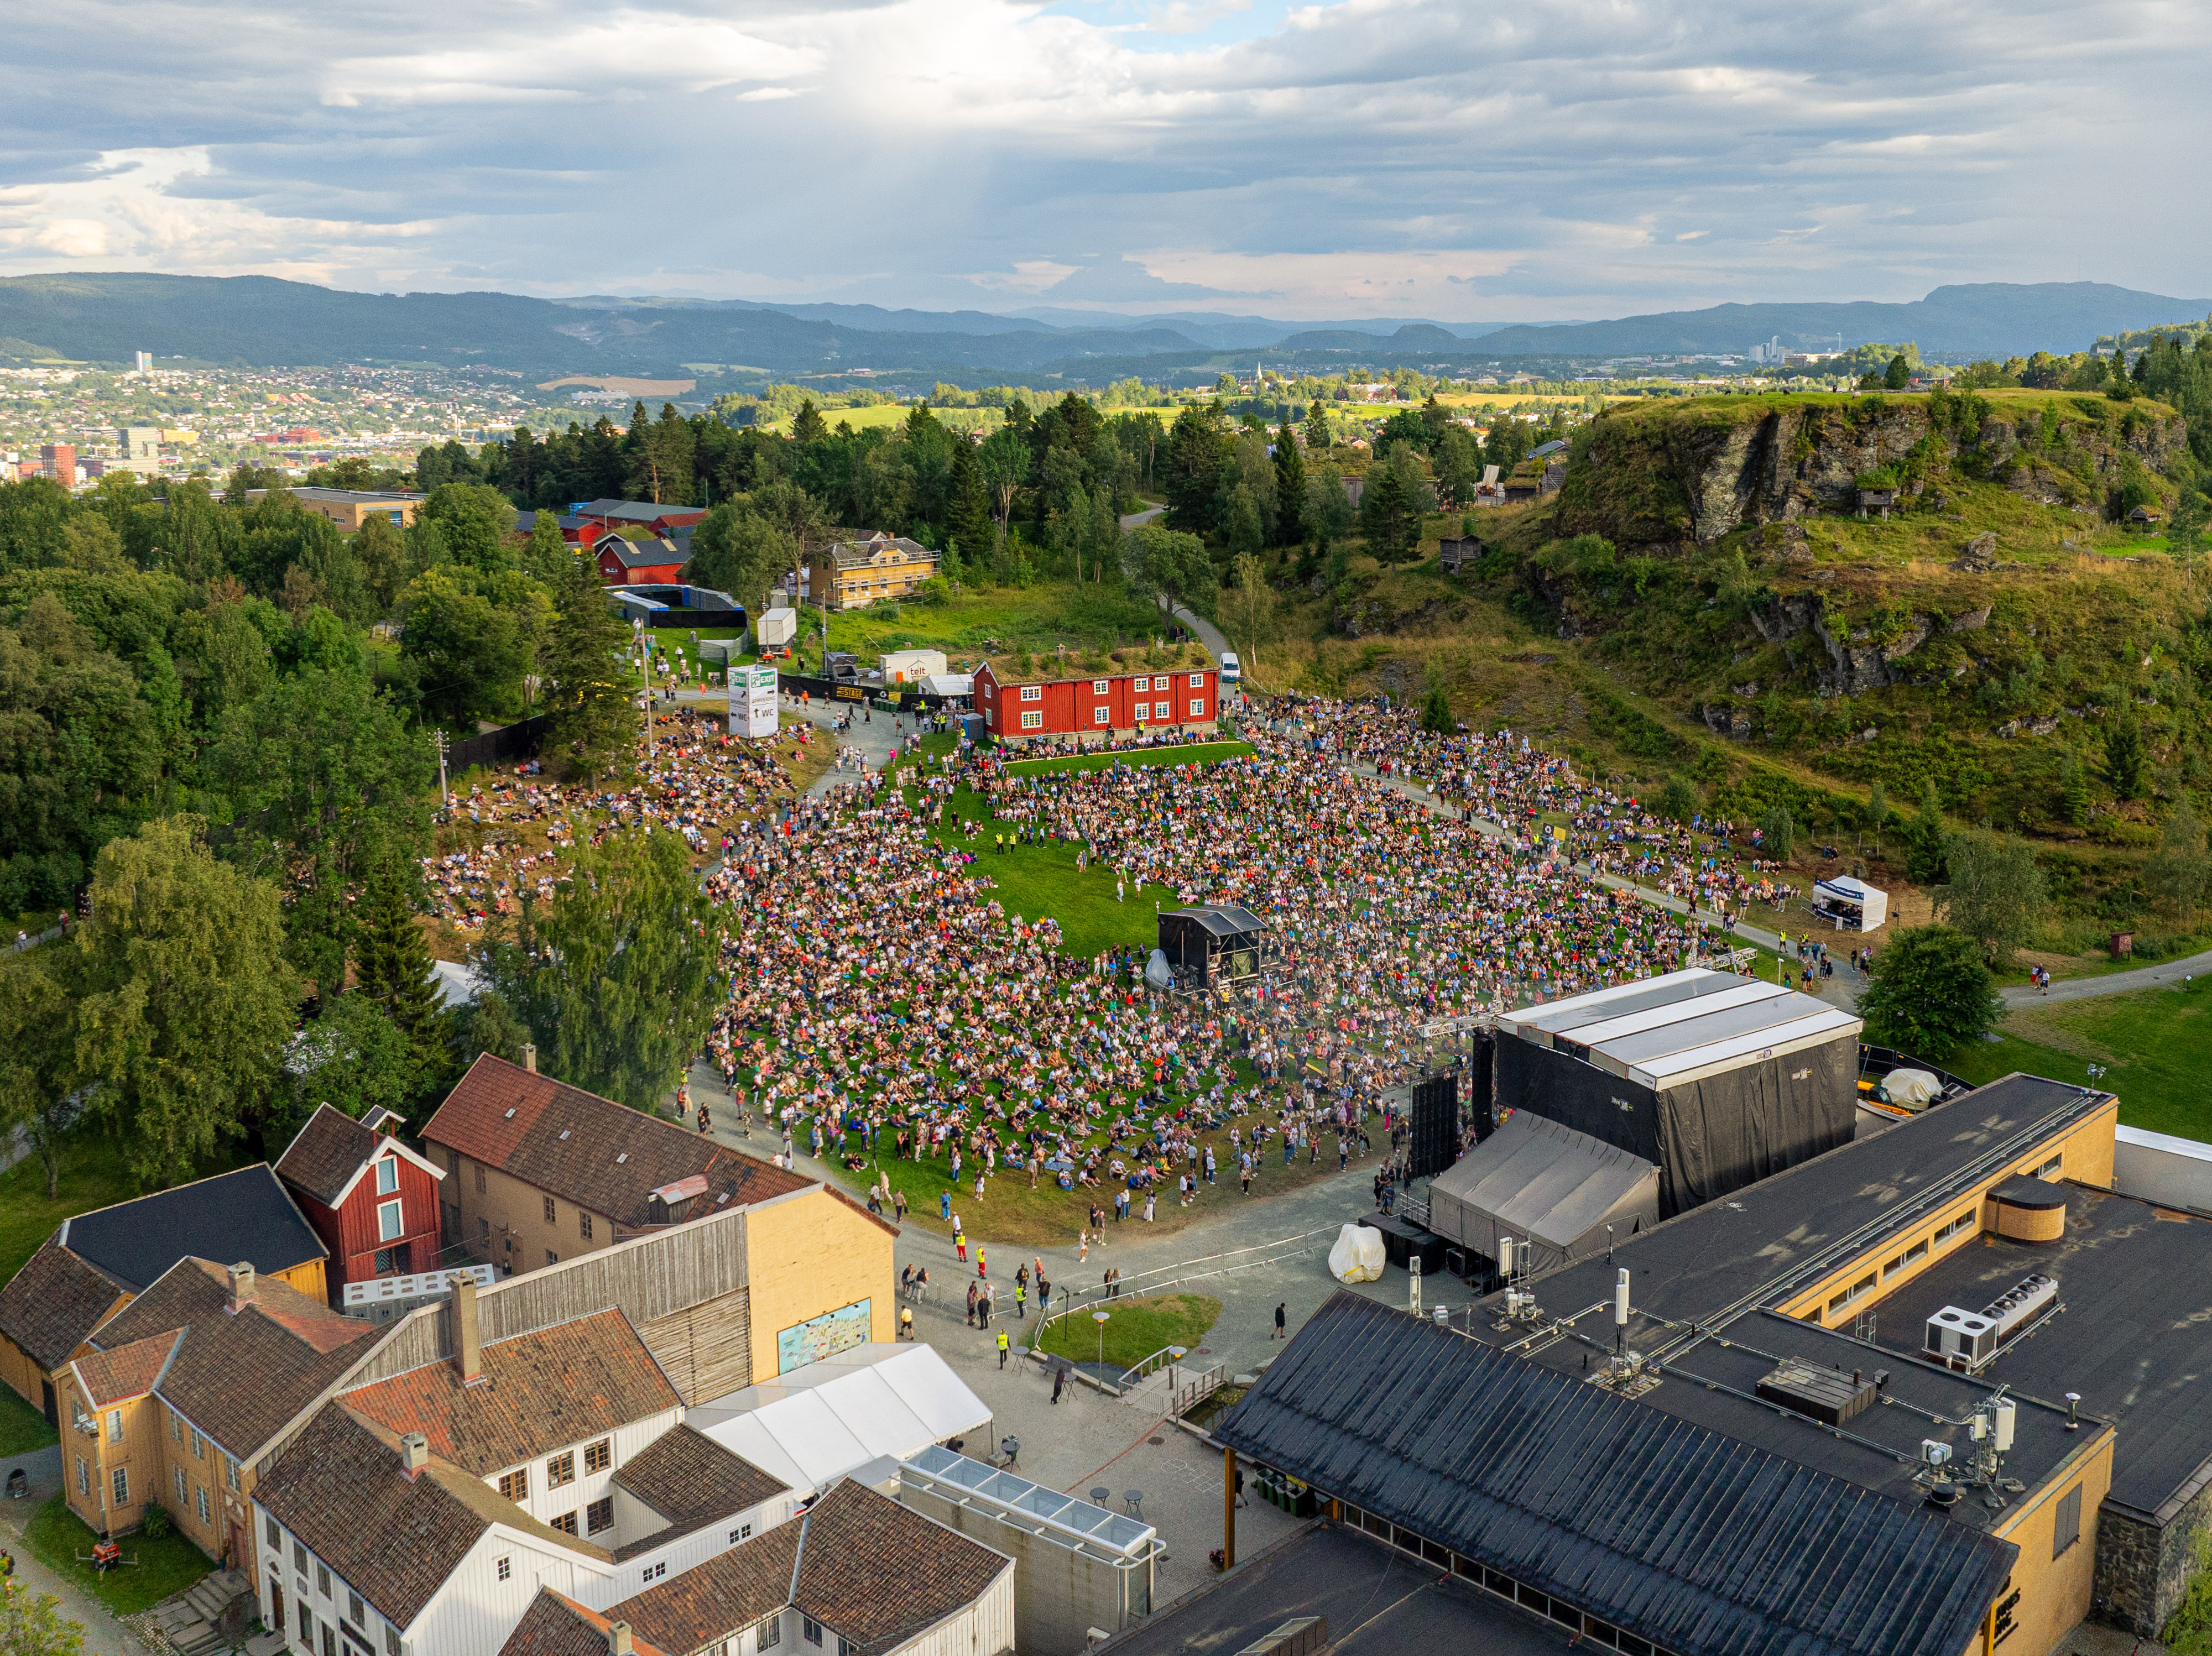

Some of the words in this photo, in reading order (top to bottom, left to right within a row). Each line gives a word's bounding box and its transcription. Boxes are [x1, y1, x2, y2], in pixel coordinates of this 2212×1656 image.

[910, 667, 926, 675] telt
[735, 675, 746, 684] EXIT
[760, 675, 775, 683] EXIT
[844, 689, 863, 698] STAGE
[738, 712, 747, 721] WC
[762, 708, 774, 717] WC
